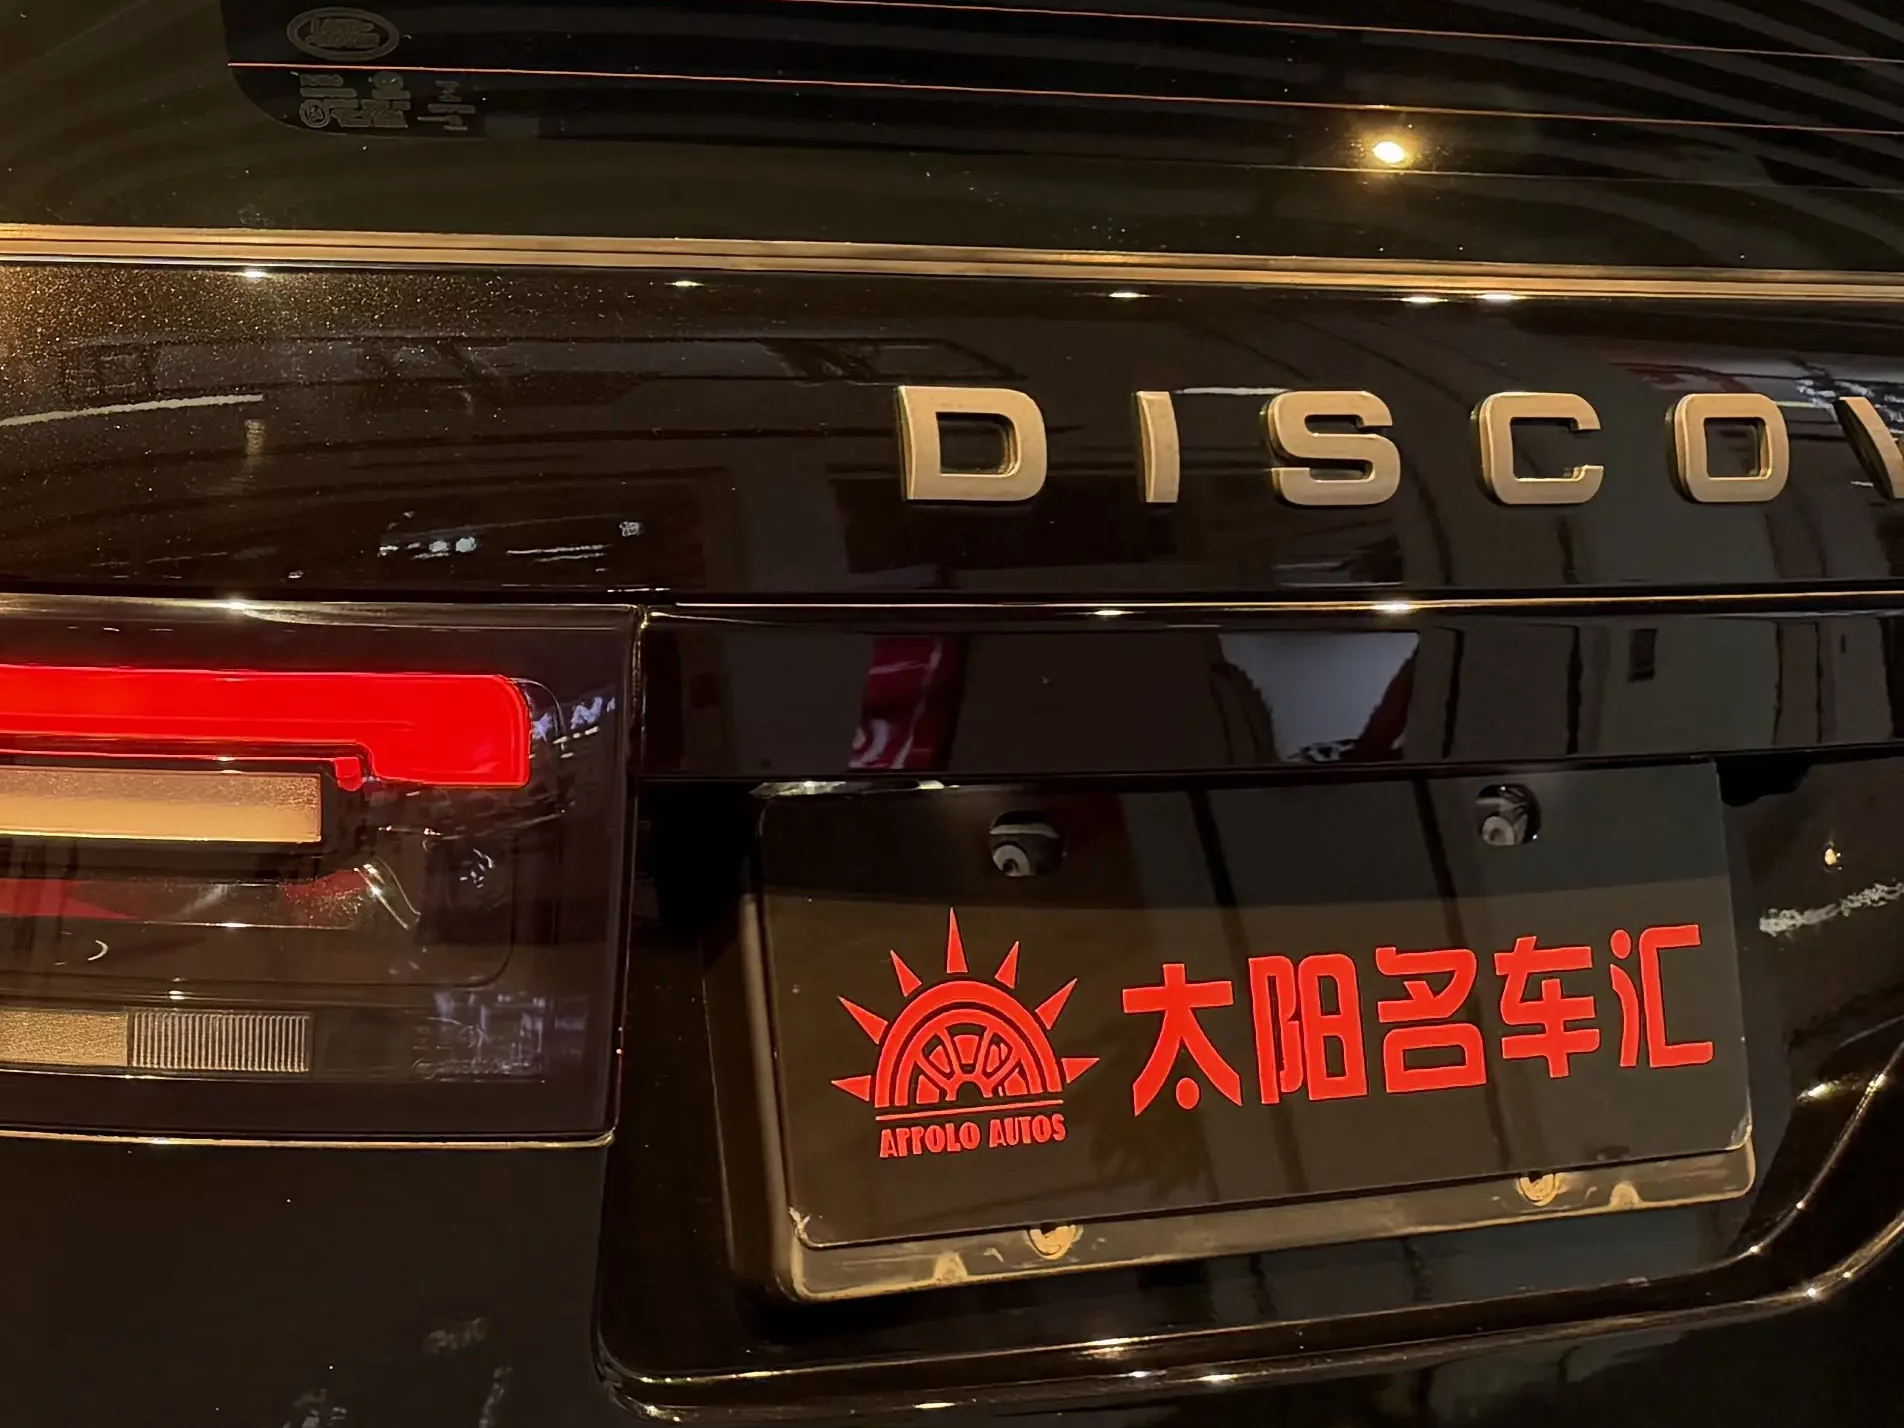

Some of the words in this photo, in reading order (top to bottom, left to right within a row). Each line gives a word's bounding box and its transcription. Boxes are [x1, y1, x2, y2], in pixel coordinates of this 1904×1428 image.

[1122, 922, 1714, 1118] 太阳名车汇
[988, 1113, 1067, 1149] AUTOS
